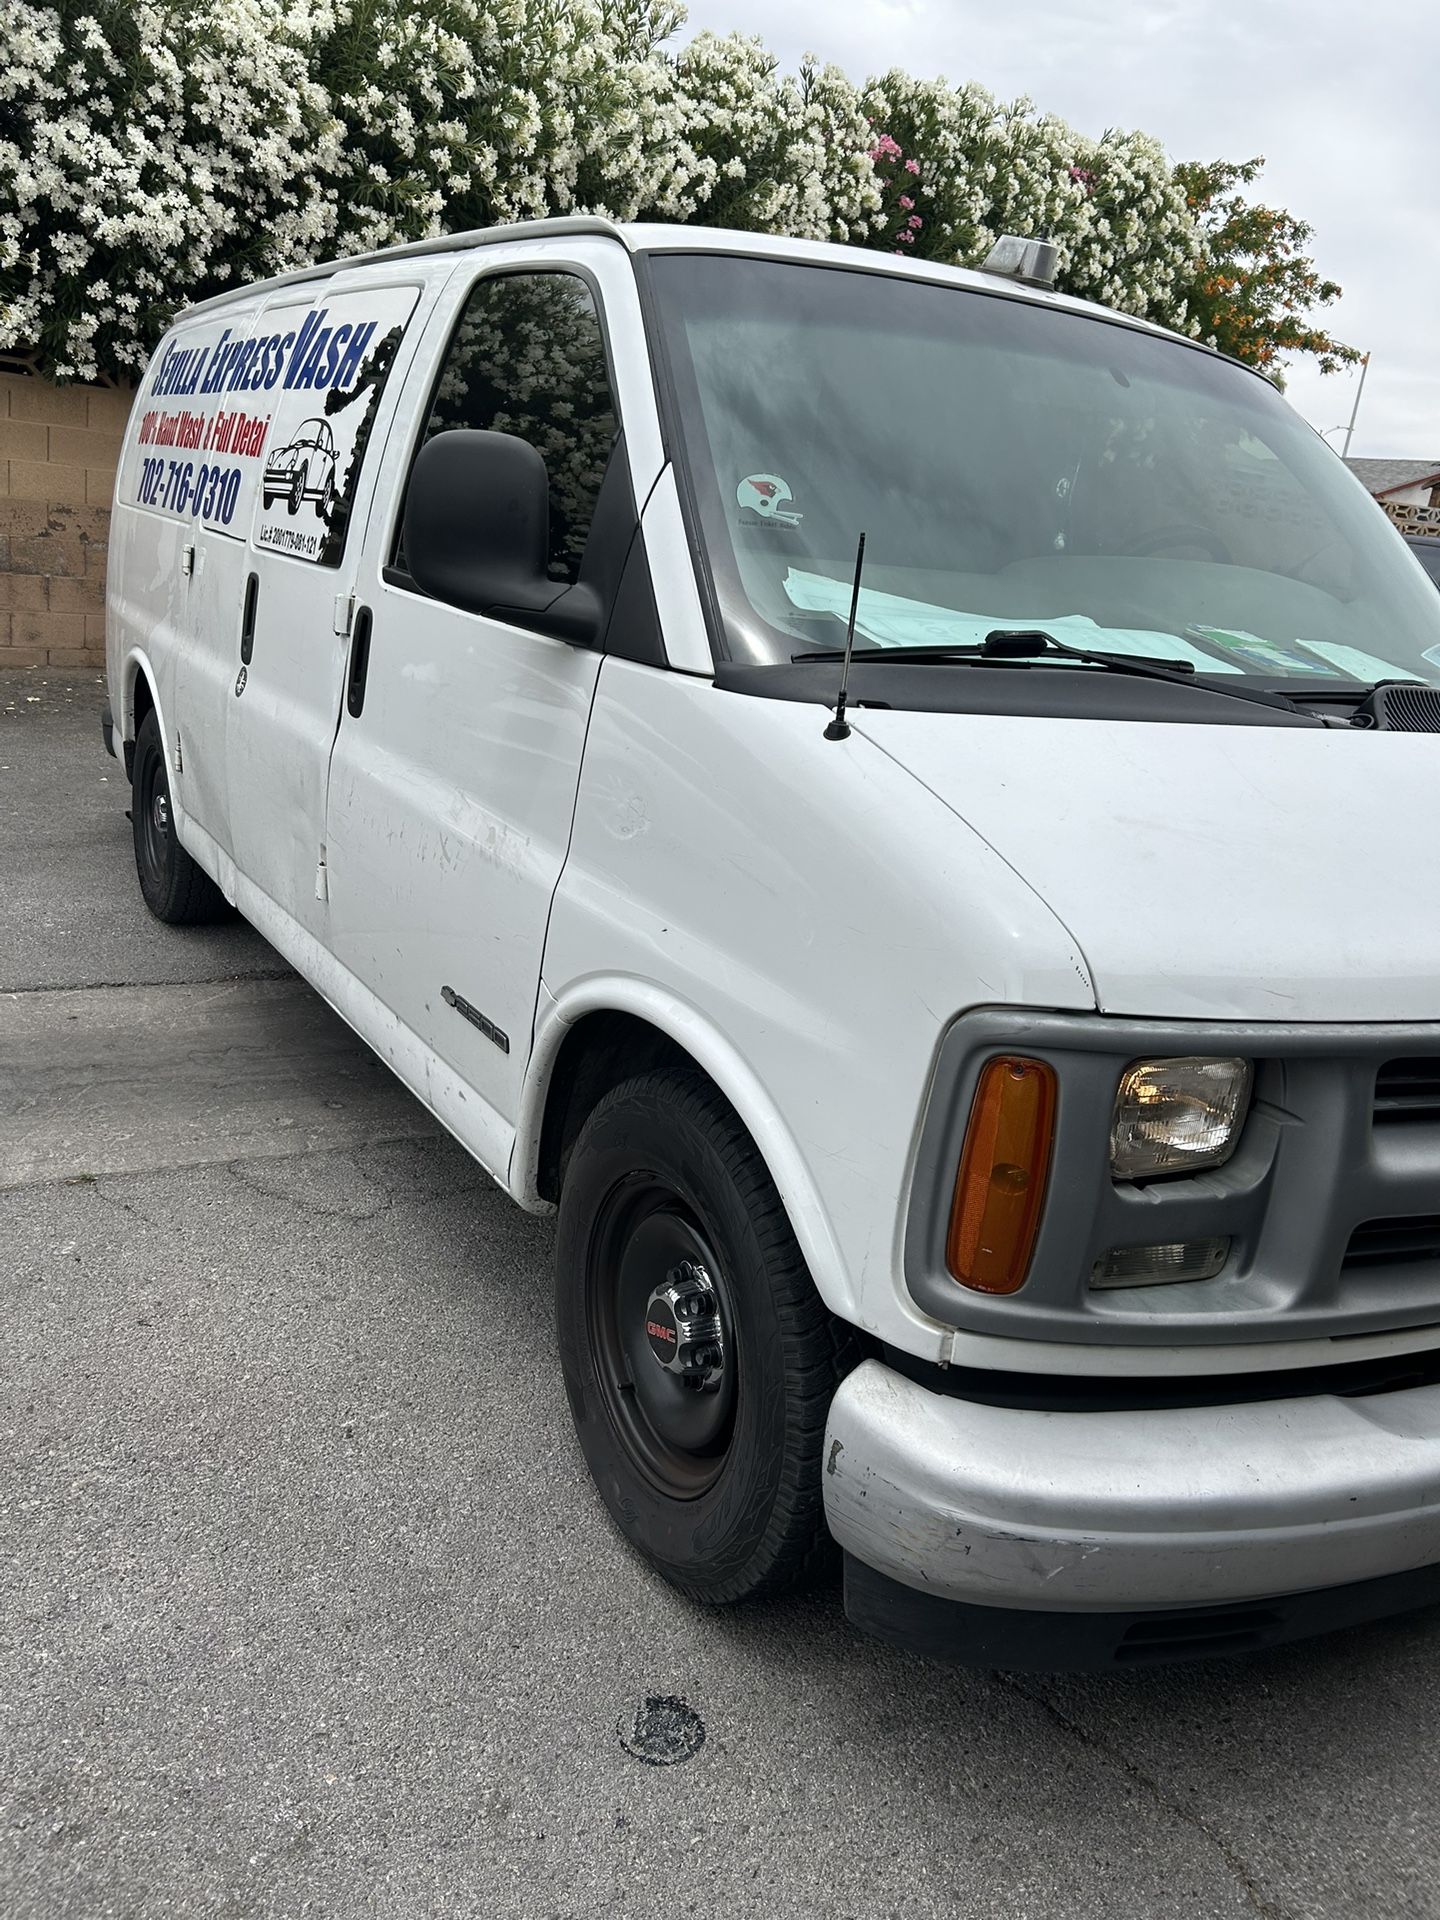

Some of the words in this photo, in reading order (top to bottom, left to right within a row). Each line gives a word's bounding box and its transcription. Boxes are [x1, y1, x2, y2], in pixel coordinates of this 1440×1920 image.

[150, 338, 211, 397] SEVILLA
[175, 411, 206, 450] Wash
[210, 411, 239, 453] Full
[136, 458, 242, 525] 702-716-0310
[646, 1320, 677, 1344] GMC
